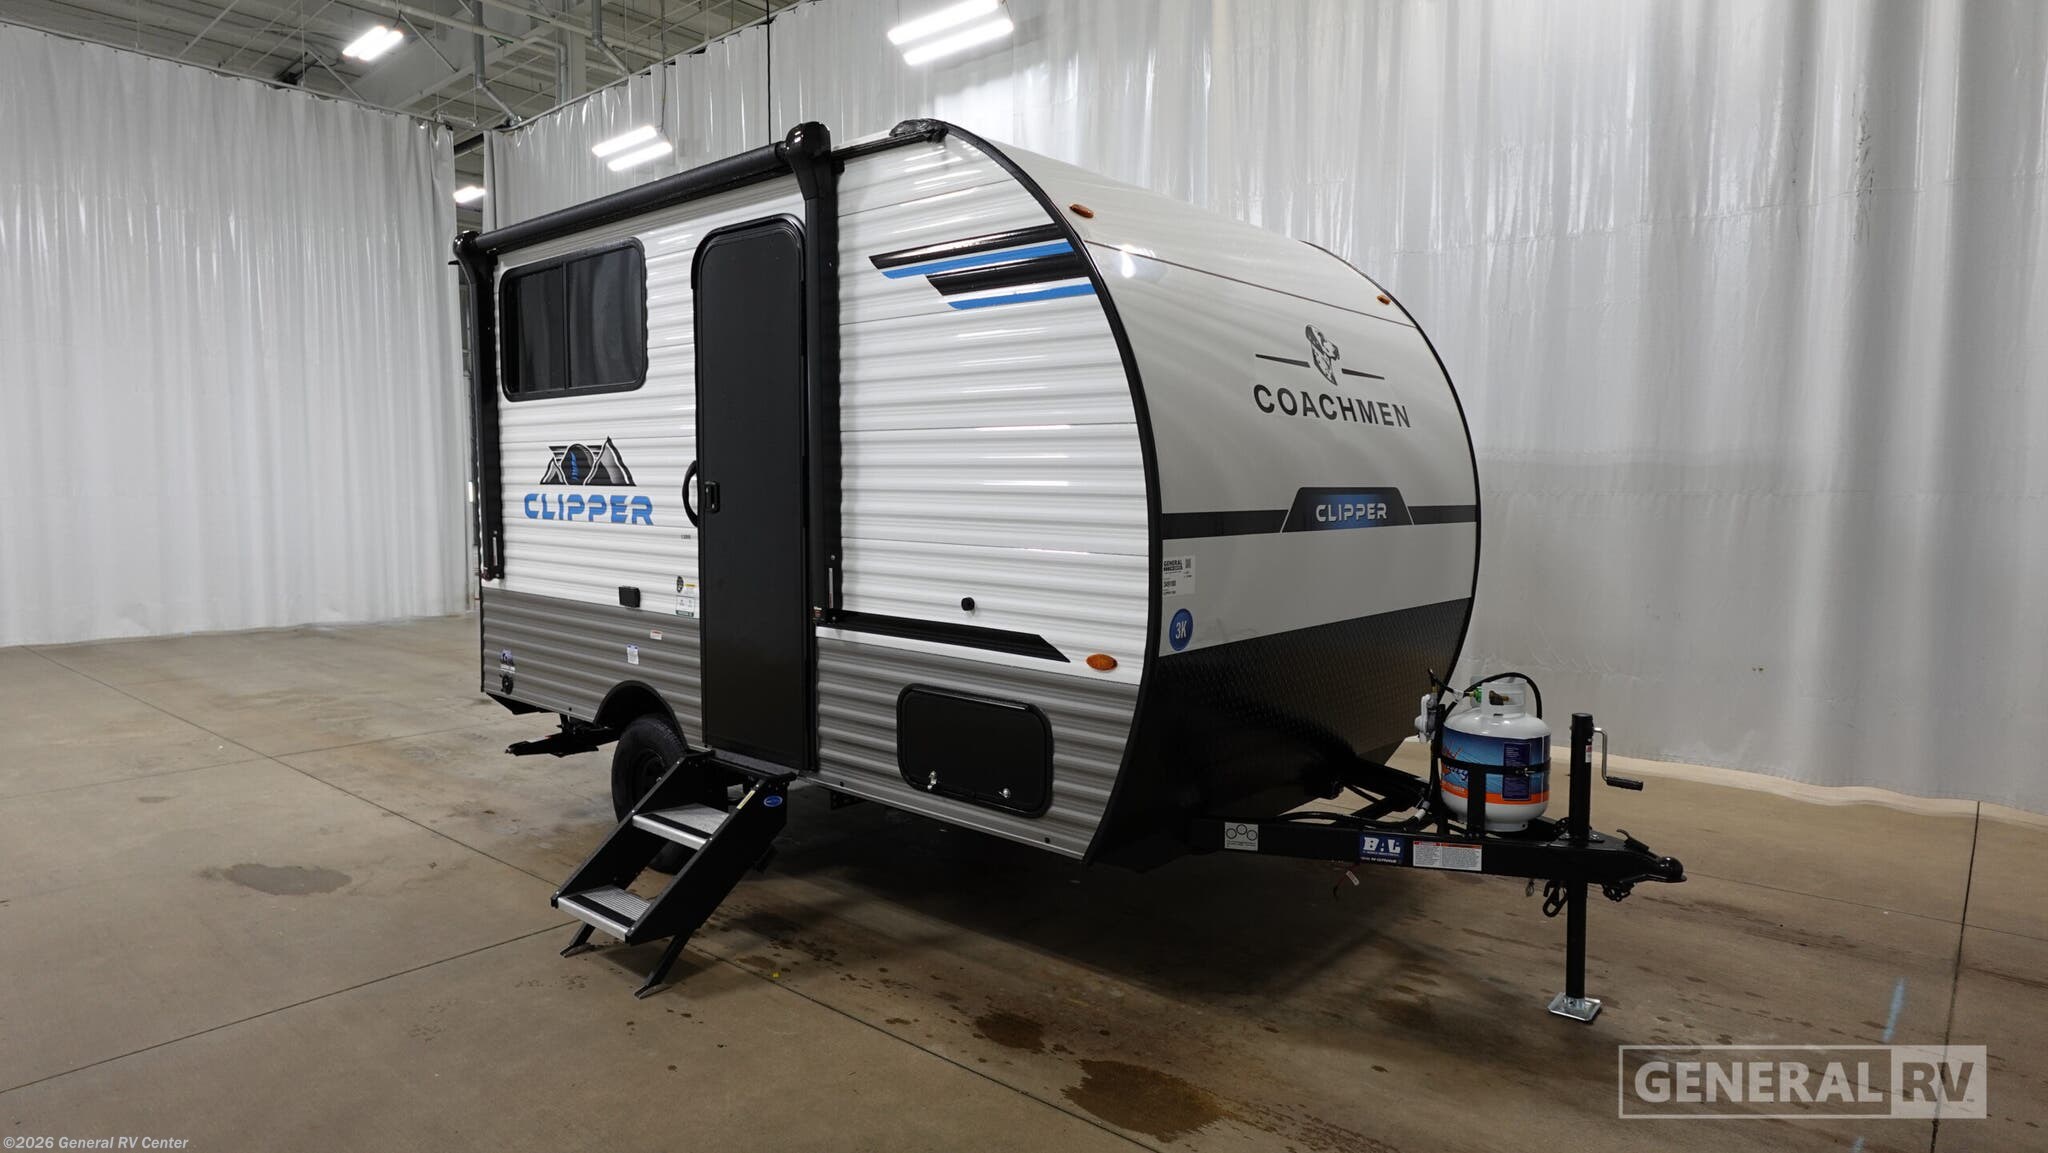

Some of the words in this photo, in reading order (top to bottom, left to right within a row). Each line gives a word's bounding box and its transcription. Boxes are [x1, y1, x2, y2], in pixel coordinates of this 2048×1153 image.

[1253, 384, 1411, 428] COACHMEN
[524, 493, 654, 526] CLIPPER
[1315, 502, 1388, 523] CLIPPER
[1176, 621, 1187, 639] 3K
